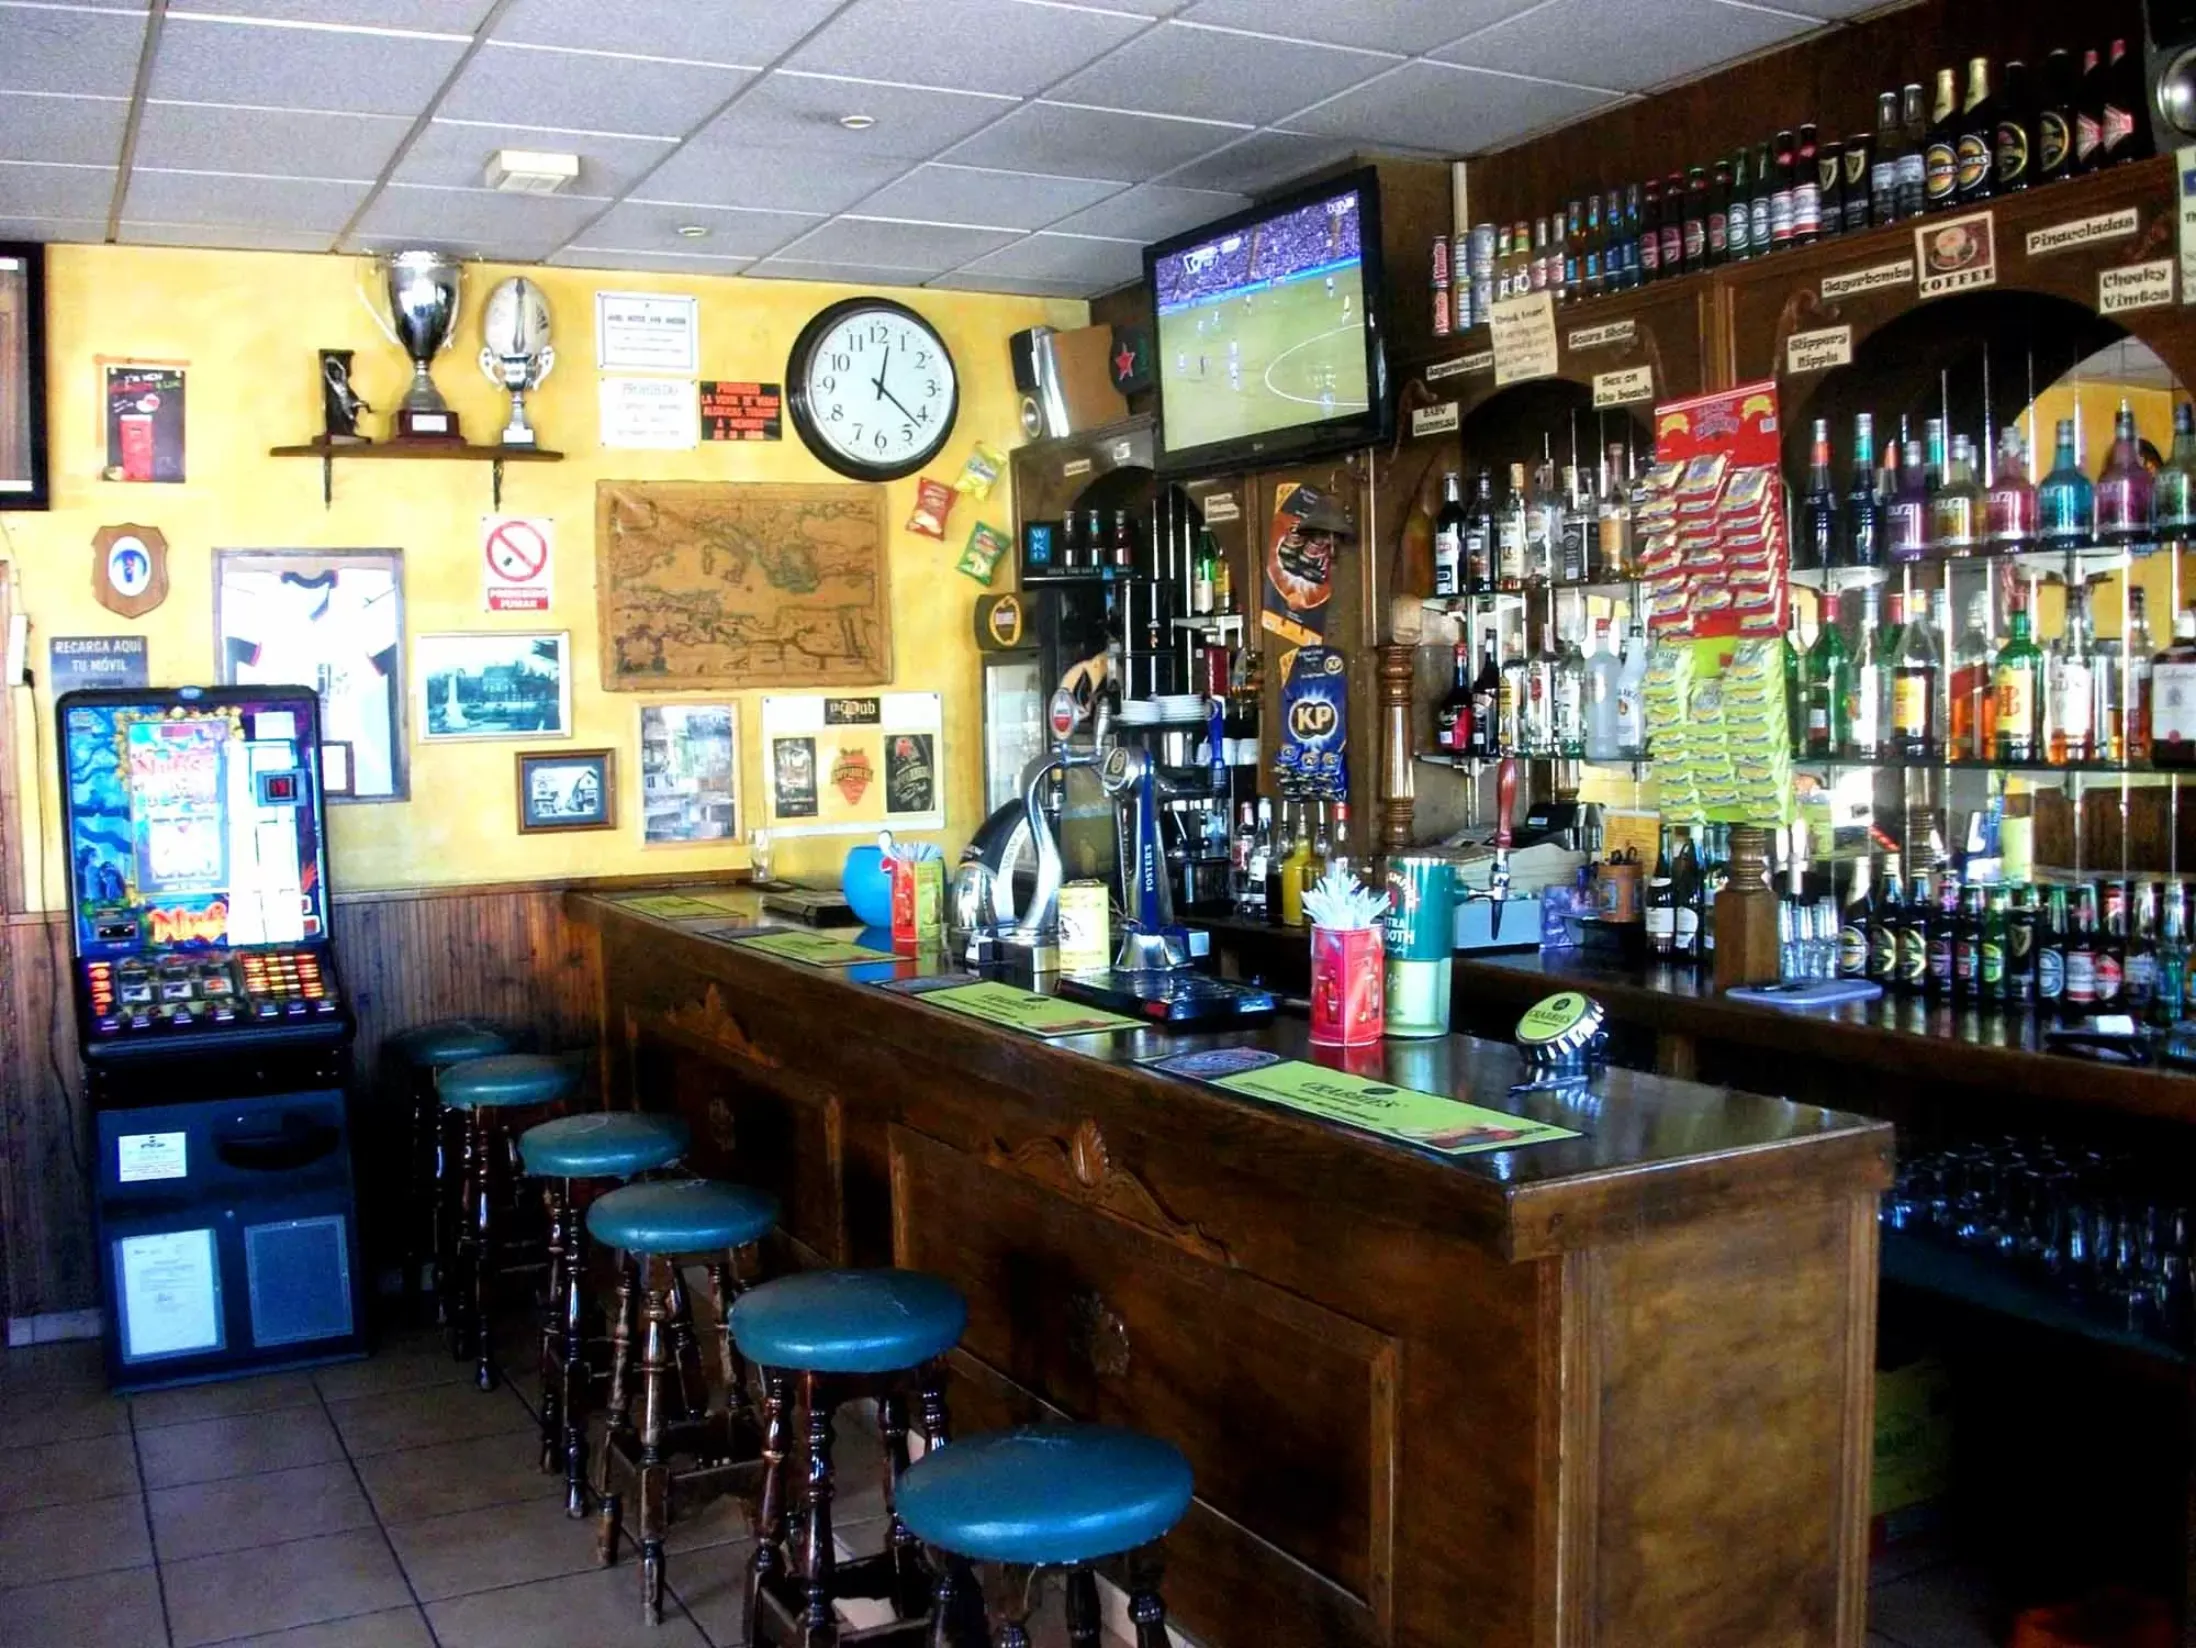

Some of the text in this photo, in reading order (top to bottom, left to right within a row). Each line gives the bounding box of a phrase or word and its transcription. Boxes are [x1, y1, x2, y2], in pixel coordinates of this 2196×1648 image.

[1921, 268, 1993, 293] COFFEE
[849, 333, 863, 352] 11
[869, 326, 889, 344] 12
[831, 354, 850, 372] 10
[914, 351, 926, 369] 2
[822, 376, 836, 394] 9
[926, 379, 936, 397] 3
[831, 404, 844, 421] 8
[916, 405, 929, 422] 4
[852, 423, 863, 441] 7
[874, 431, 887, 449] 6
[901, 424, 913, 441] 5
[55, 641, 109, 653] RECARGA
[72, 659, 86, 671] TU
[1297, 706, 1332, 731] KP
